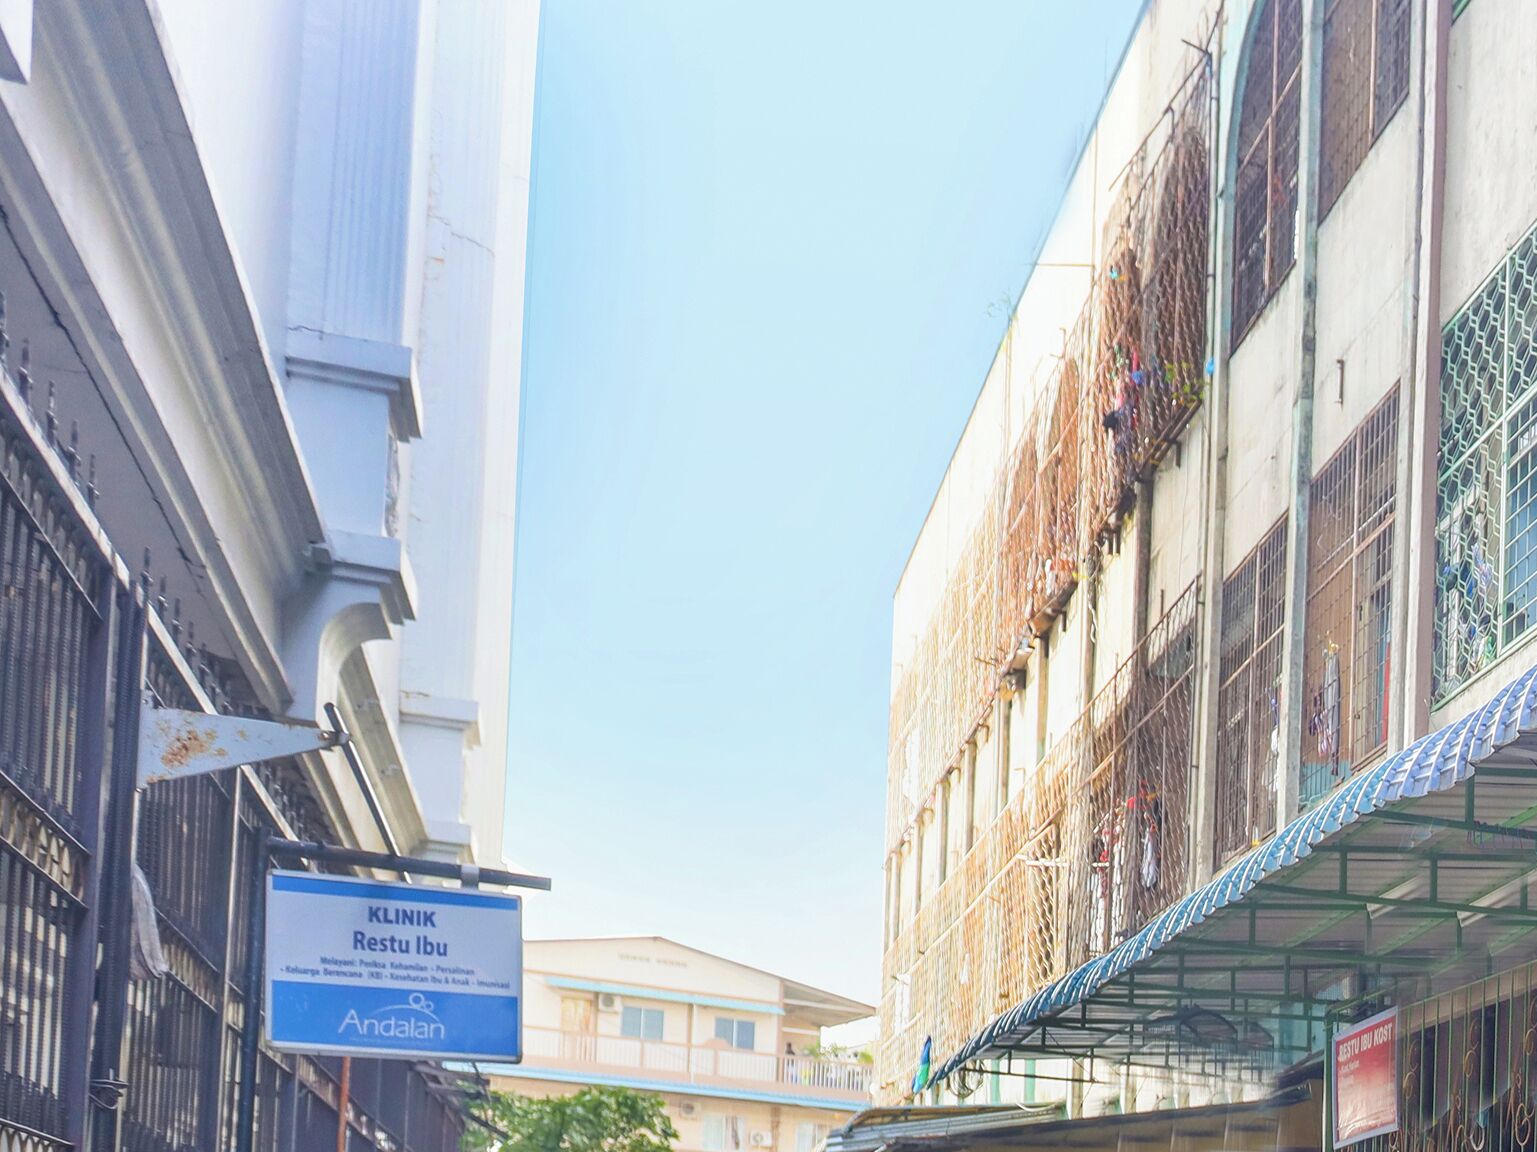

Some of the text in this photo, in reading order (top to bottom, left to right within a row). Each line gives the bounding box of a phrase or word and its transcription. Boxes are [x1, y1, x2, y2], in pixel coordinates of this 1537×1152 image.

[368, 906, 436, 928] KLINIK
[353, 930, 448, 957] Restu Ibu
[338, 1008, 445, 1040] Andalan
[1360, 1031, 1373, 1052] IBU
[1373, 1022, 1393, 1047] KOST
